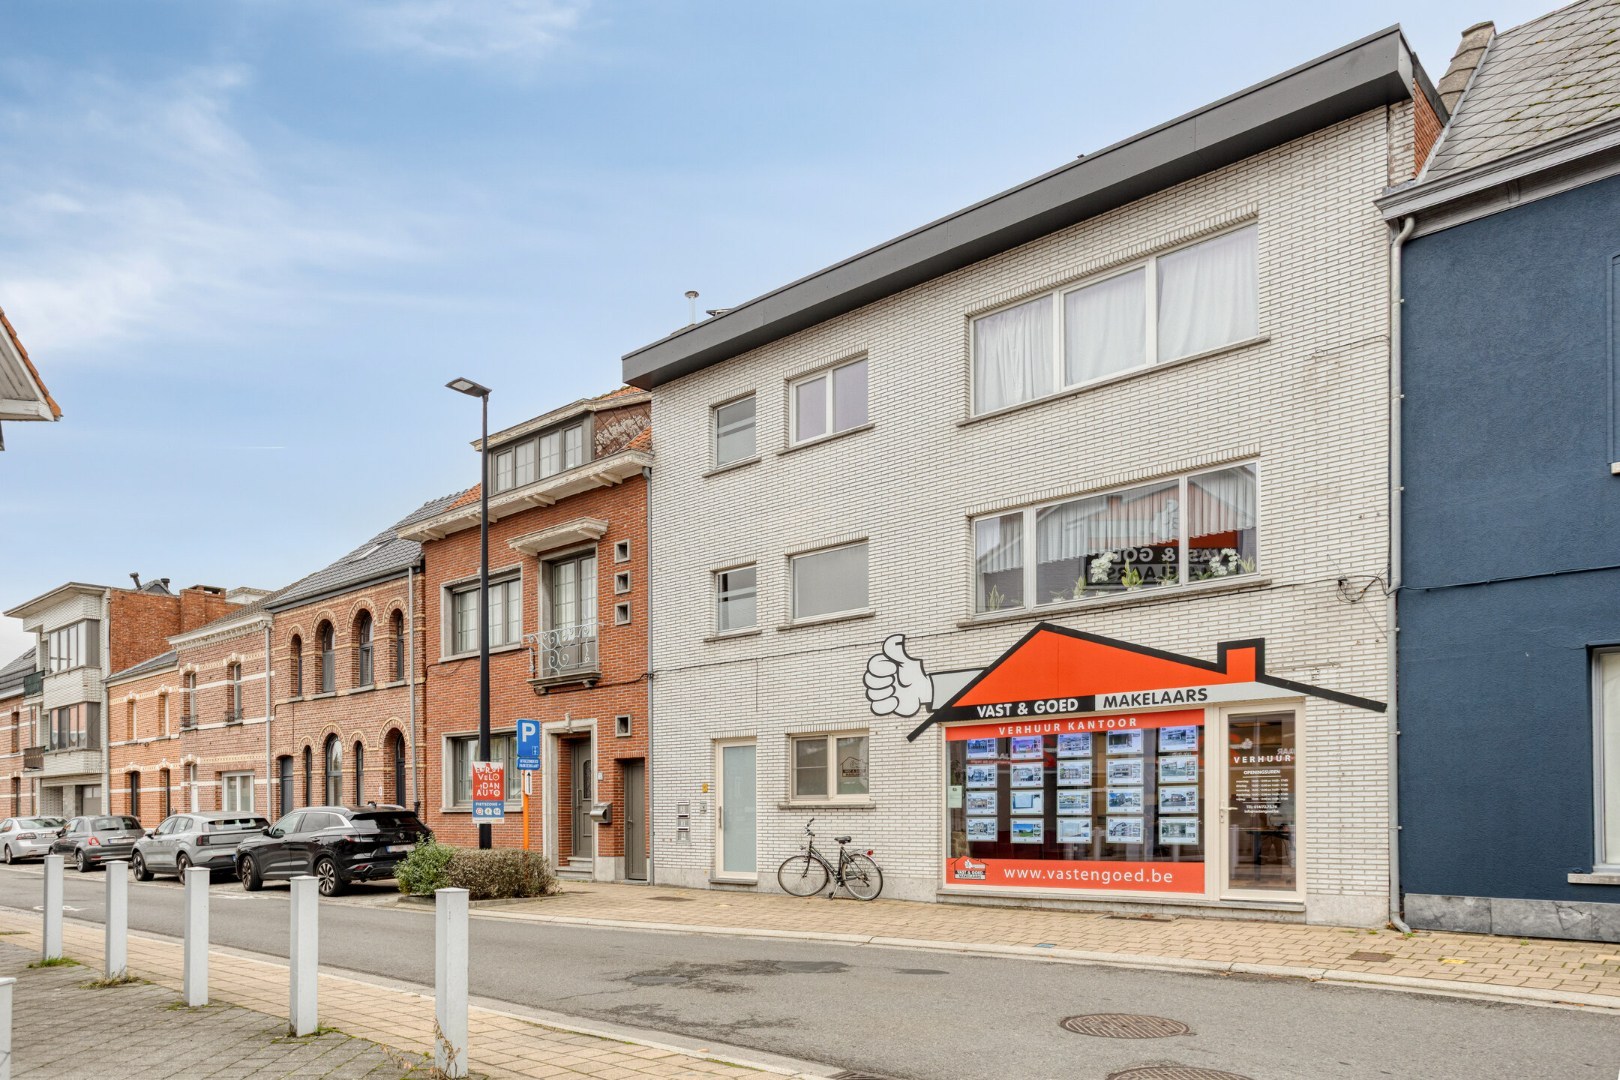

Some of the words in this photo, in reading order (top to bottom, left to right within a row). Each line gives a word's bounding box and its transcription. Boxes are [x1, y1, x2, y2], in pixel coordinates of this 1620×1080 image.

[977, 703, 1012, 718] VAST
[1017, 702, 1028, 715] &
[1034, 699, 1078, 714] GOED
[1103, 688, 1208, 709] MAKELAARS
[522, 722, 536, 743] P
[999, 723, 1061, 736] VERHUUR
[1068, 717, 1137, 731] KANTOOR
[1233, 754, 1291, 764] VERHUUR
[477, 773, 500, 781] VELO
[476, 789, 501, 797] AUTO
[1004, 868, 1173, 884] www.vastengoed.be
